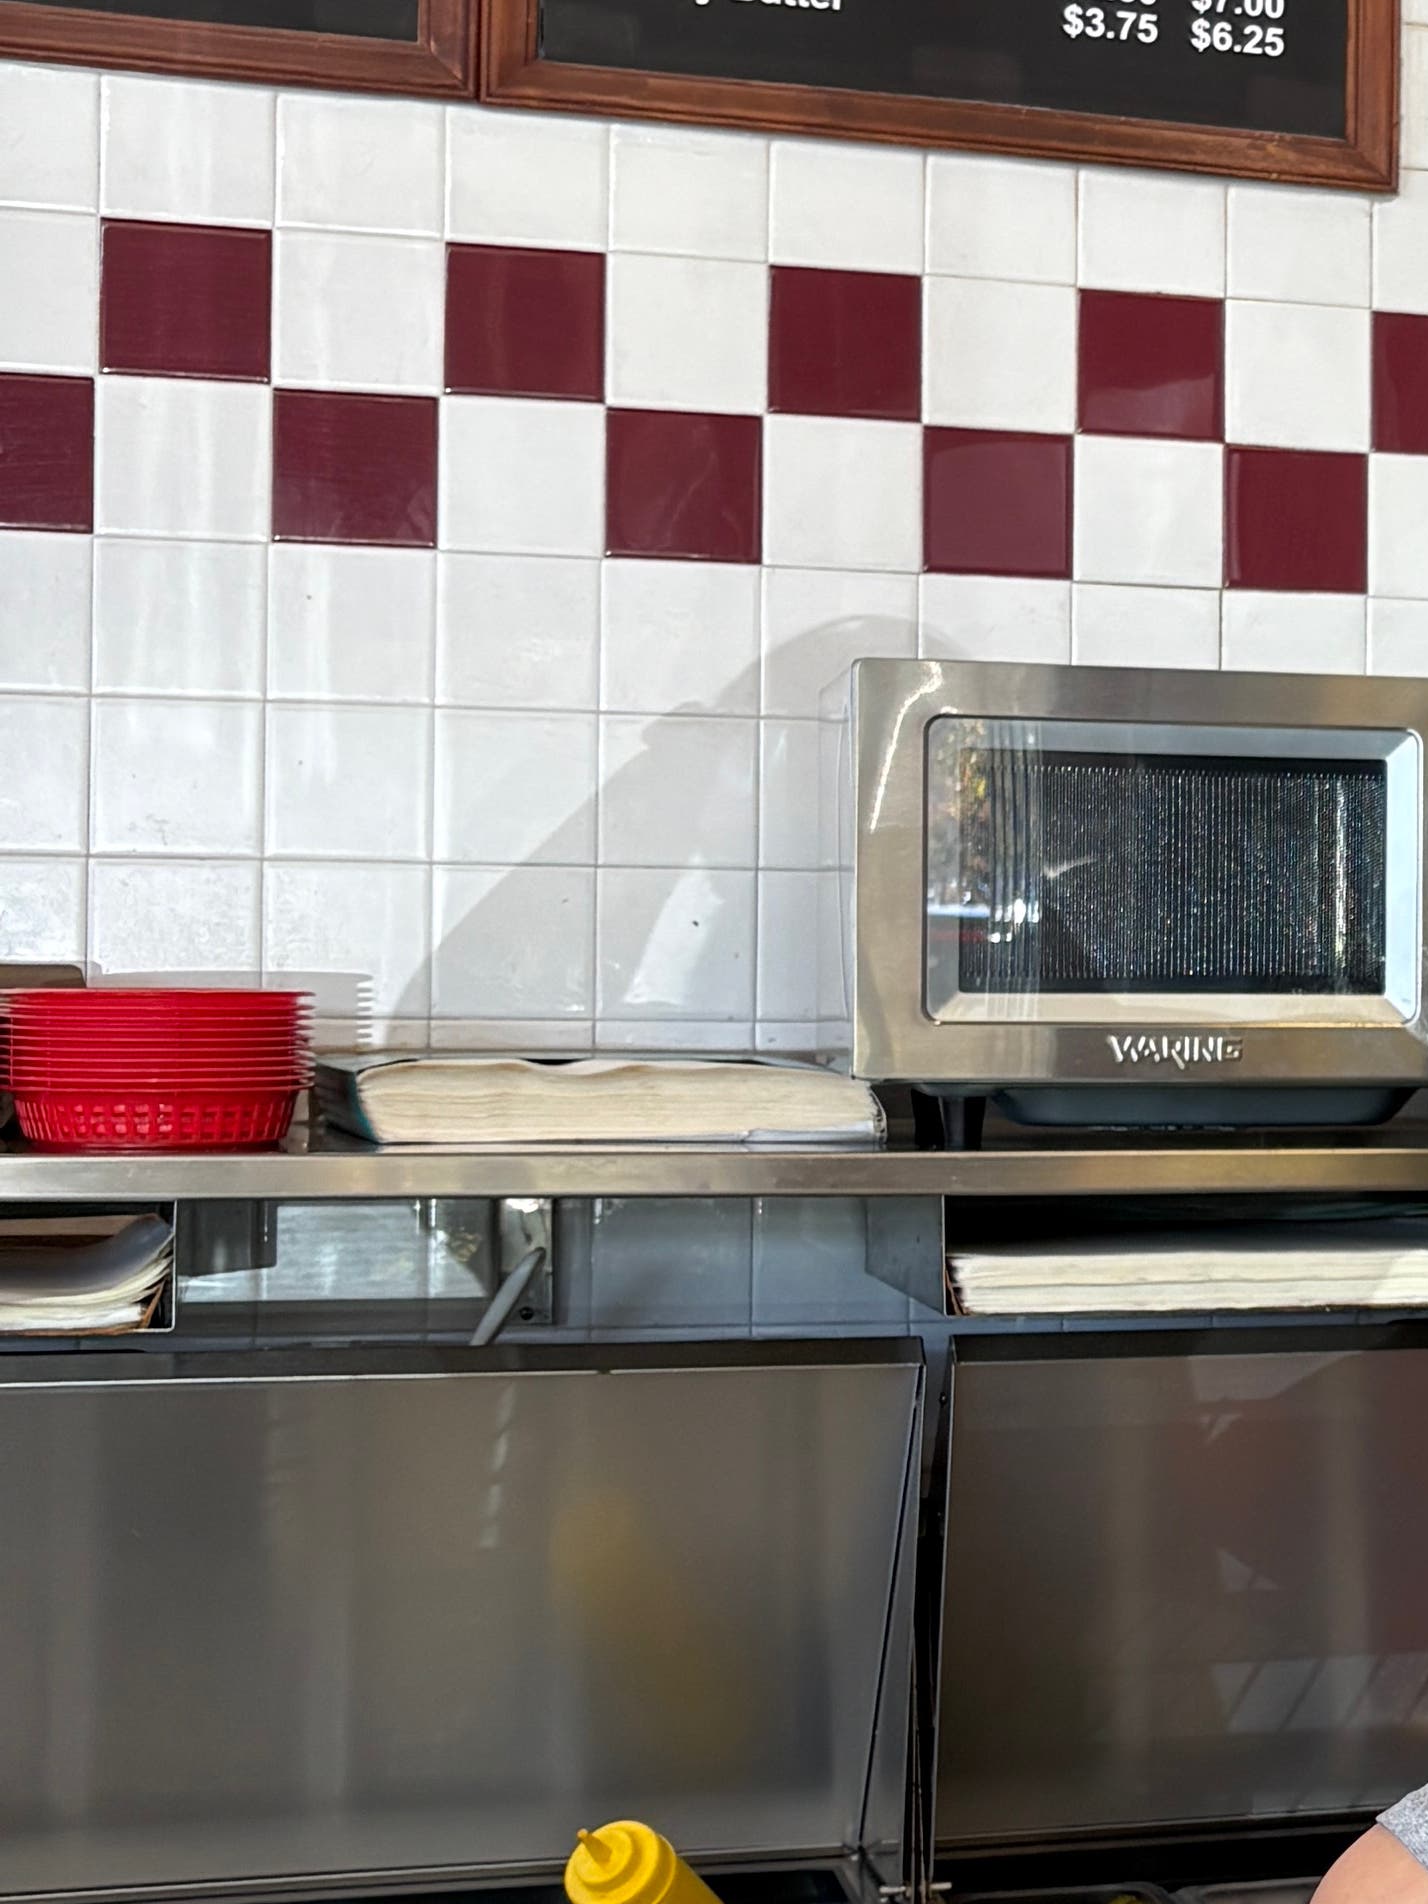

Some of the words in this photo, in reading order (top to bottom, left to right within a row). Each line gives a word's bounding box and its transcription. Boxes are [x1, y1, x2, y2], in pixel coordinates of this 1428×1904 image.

[1063, 4, 1158, 43] $3.75
[1191, 17, 1284, 56] $6.25
[1106, 1035, 1243, 1070] WARING
